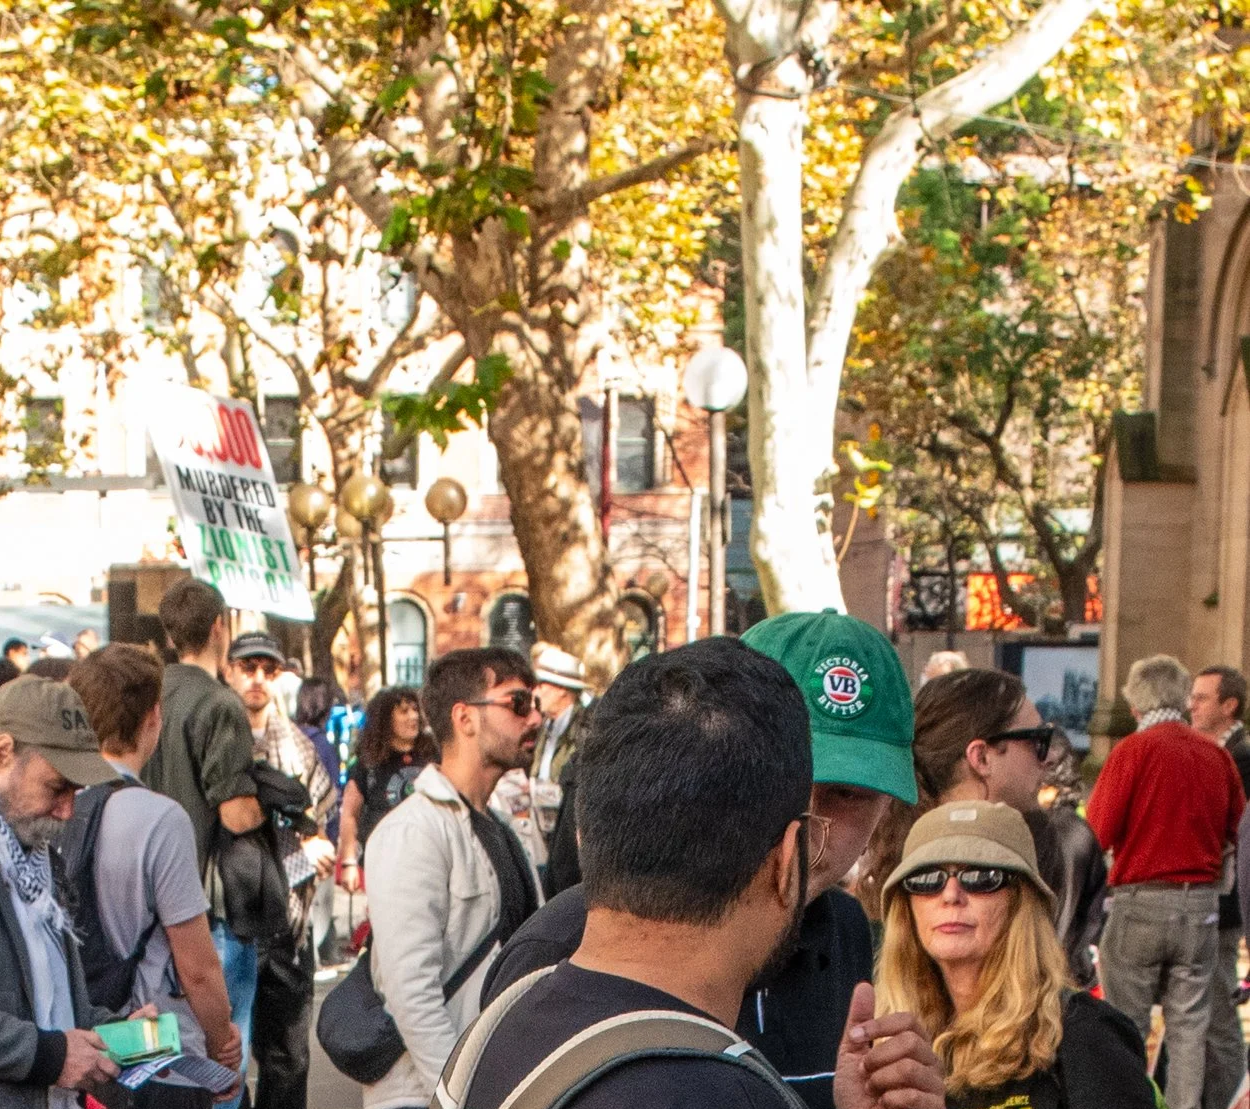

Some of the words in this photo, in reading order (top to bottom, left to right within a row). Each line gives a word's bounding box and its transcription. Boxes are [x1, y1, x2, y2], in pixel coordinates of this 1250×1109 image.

[175, 464, 276, 508] MURDERED
[203, 498, 227, 527] BY
[232, 505, 268, 535] THE
[196, 523, 292, 573] ZIONIST
[815, 657, 869, 682] VICTORIA
[828, 675, 857, 694] VB
[818, 695, 865, 715] BITTER
